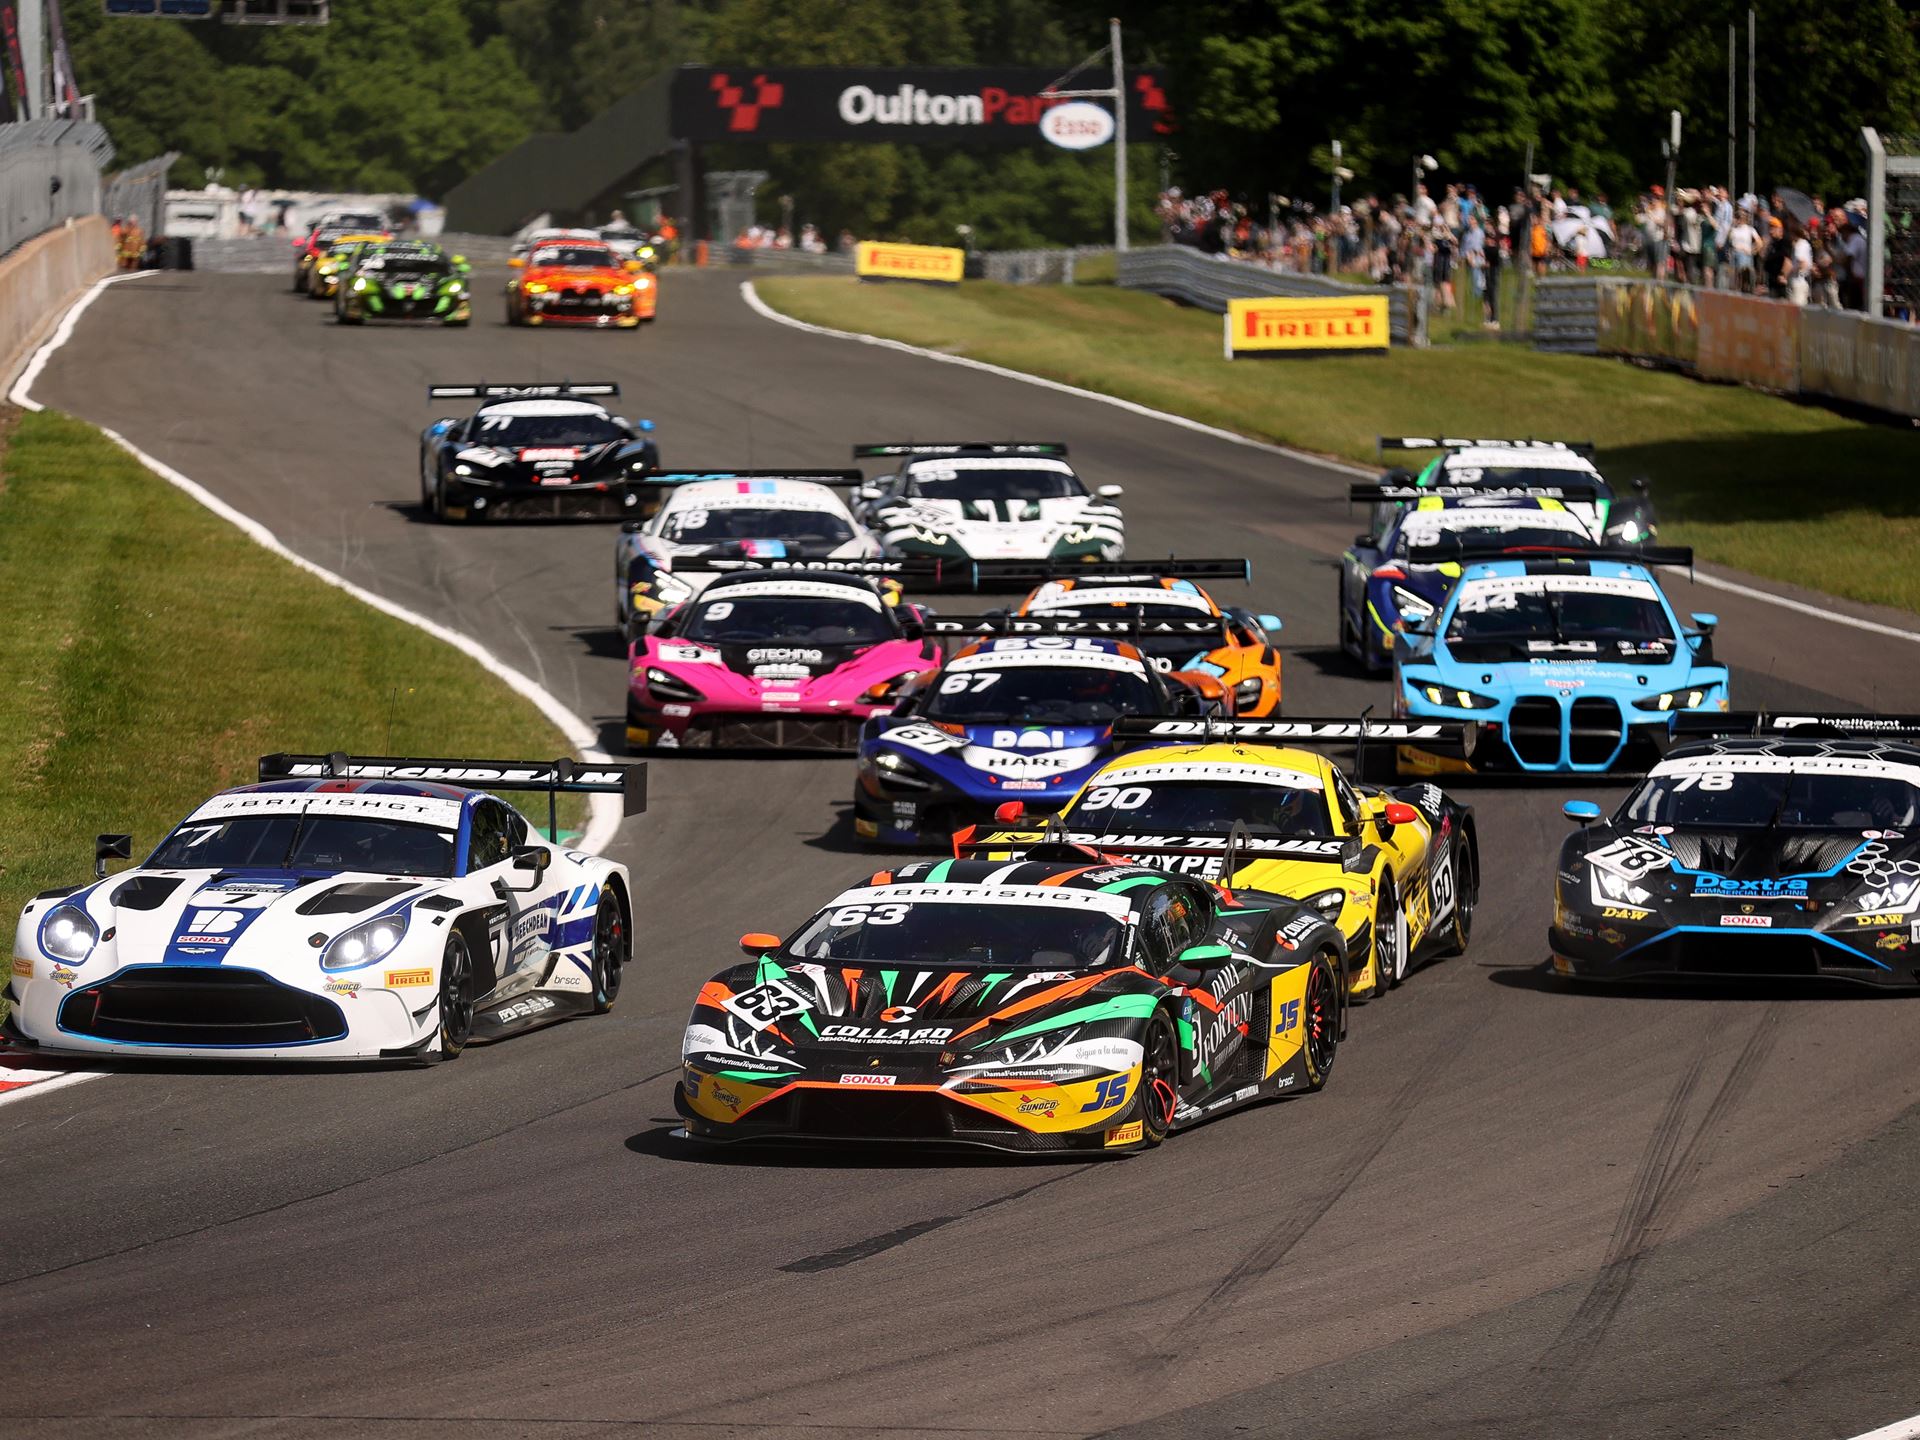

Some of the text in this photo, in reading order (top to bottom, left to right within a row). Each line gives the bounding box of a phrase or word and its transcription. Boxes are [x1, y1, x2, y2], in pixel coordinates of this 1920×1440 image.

[1246, 309, 1371, 337] PIRELLI
[483, 415, 513, 430] 71
[674, 510, 709, 529] 18
[771, 561, 902, 571] PADDOCK
[704, 602, 734, 620] 9
[1459, 594, 1518, 613] 44
[939, 673, 1001, 694] 67
[1149, 720, 1442, 738] OPTIMUM
[896, 729, 947, 746] 67
[988, 758, 1069, 768] HARE
[1688, 759, 1891, 771] #BRITISHGT
[1104, 765, 1304, 781] #BRITISHGT
[1670, 773, 1734, 792] 78
[223, 798, 429, 812] #BRITISHGT
[1081, 787, 1152, 810] 90
[188, 824, 225, 847] 7
[1601, 839, 1664, 871] 78
[1695, 875, 1808, 890] Dextra
[222, 893, 258, 904] 7
[873, 888, 1098, 903] #BRITISHGT
[1435, 866, 1451, 916] 90
[1694, 888, 1758, 896] COMMERCIAL
[829, 903, 910, 926] 63
[1722, 916, 1768, 925] SONAX
[179, 936, 226, 944] SONAX
[51, 971, 79, 980] SUNOCO
[389, 971, 431, 985] PIRELLI
[554, 974, 581, 985] brscc
[326, 981, 360, 991] SUNOCO
[1211, 963, 1240, 1004] DAMA
[734, 984, 800, 1022] 63
[818, 1036, 862, 1044] DEMOLISH
[821, 1024, 954, 1041] COLLARD
[704, 1053, 780, 1071] DamaFortunaTequila.com
[983, 1067, 1085, 1078] DamaFortunaTequila.com
[841, 1076, 892, 1085] SONAX
[713, 1091, 741, 1105] SUNOCO
[1019, 1101, 1057, 1112] SUNOCO
[1109, 1125, 1142, 1141] PIRELLI
